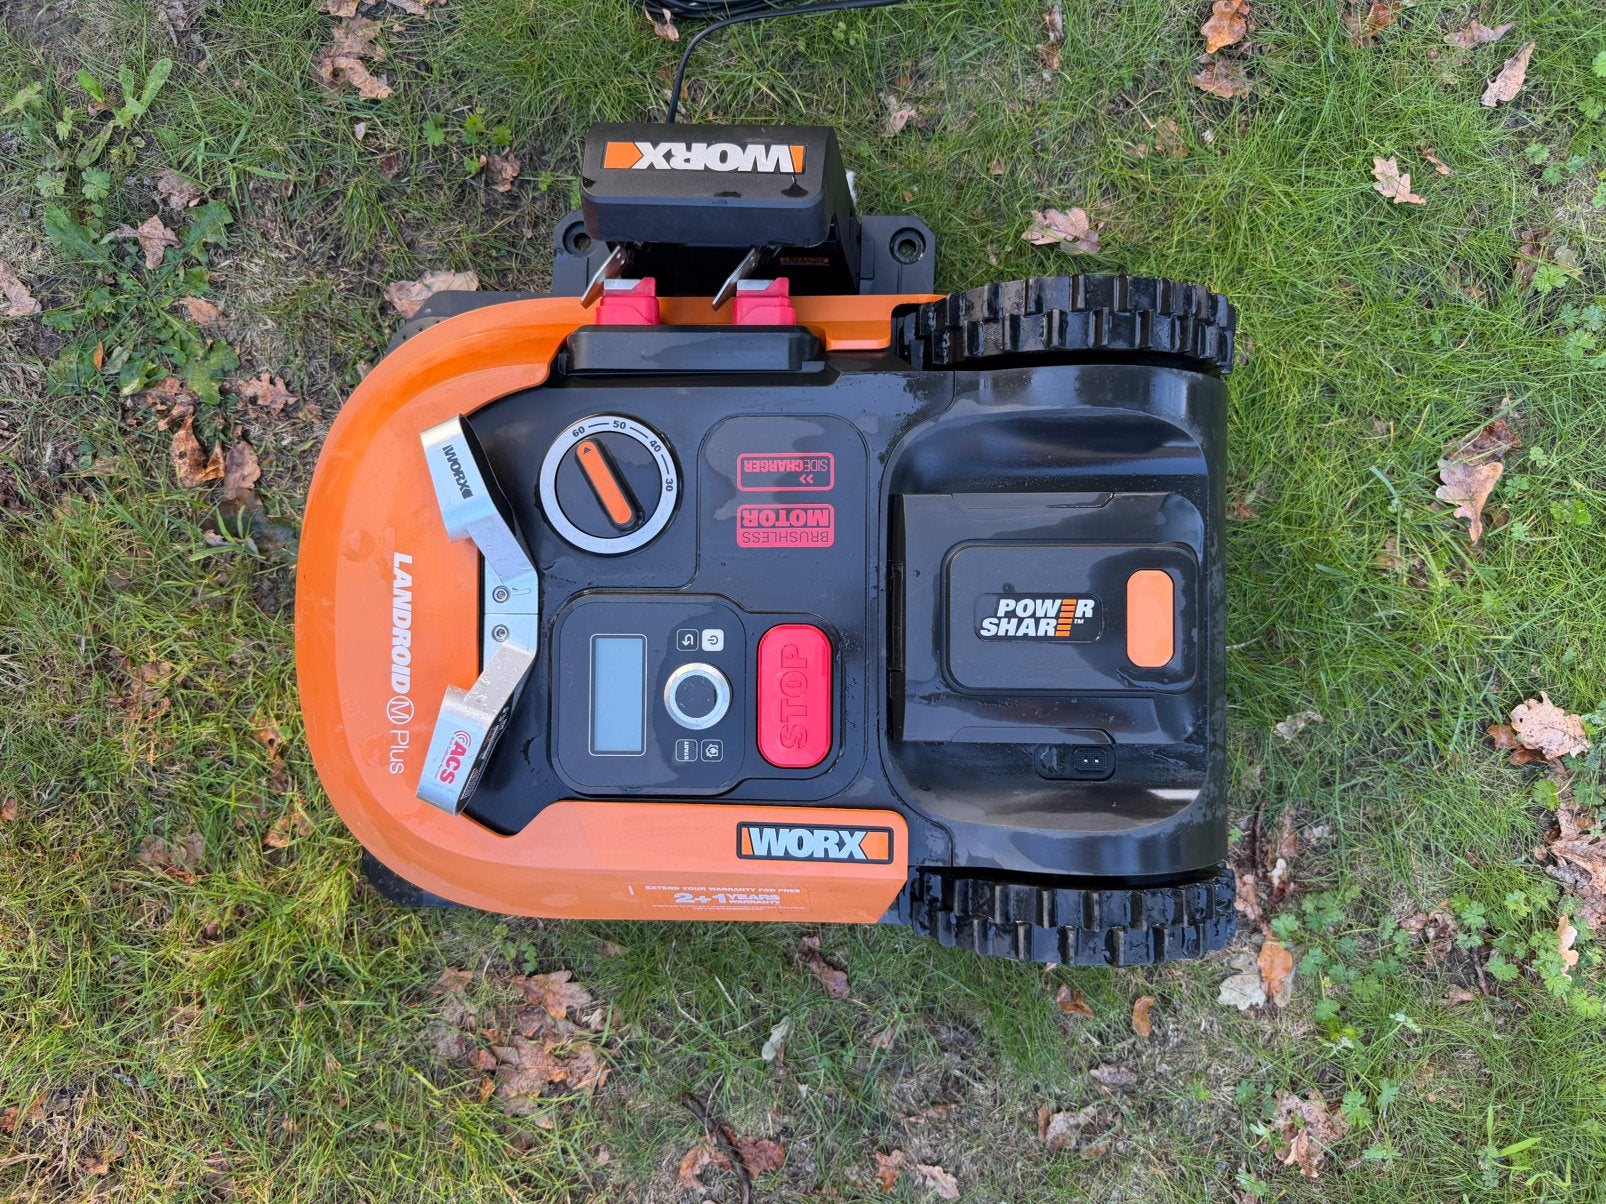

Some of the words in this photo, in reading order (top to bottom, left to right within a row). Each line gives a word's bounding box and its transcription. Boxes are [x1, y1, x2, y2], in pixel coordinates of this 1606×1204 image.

[631, 142, 794, 173] WORX
[572, 426, 585, 437] 60
[613, 420, 626, 429] 50
[649, 440, 662, 452] 40
[444, 447, 471, 495] WORX
[743, 460, 828, 472] SIDECHARGER
[665, 478, 673, 492] 30
[742, 509, 829, 527] MOTOR
[742, 532, 829, 543] BRUSHLESS
[997, 599, 1095, 617] POWER
[391, 552, 413, 694] LANDROID
[980, 618, 1072, 637] SHARE
[780, 643, 808, 749] STOP
[390, 730, 410, 775] Plus
[440, 741, 467, 784] ACS
[749, 827, 868, 860] WORX
[673, 893, 727, 904] 2+1
